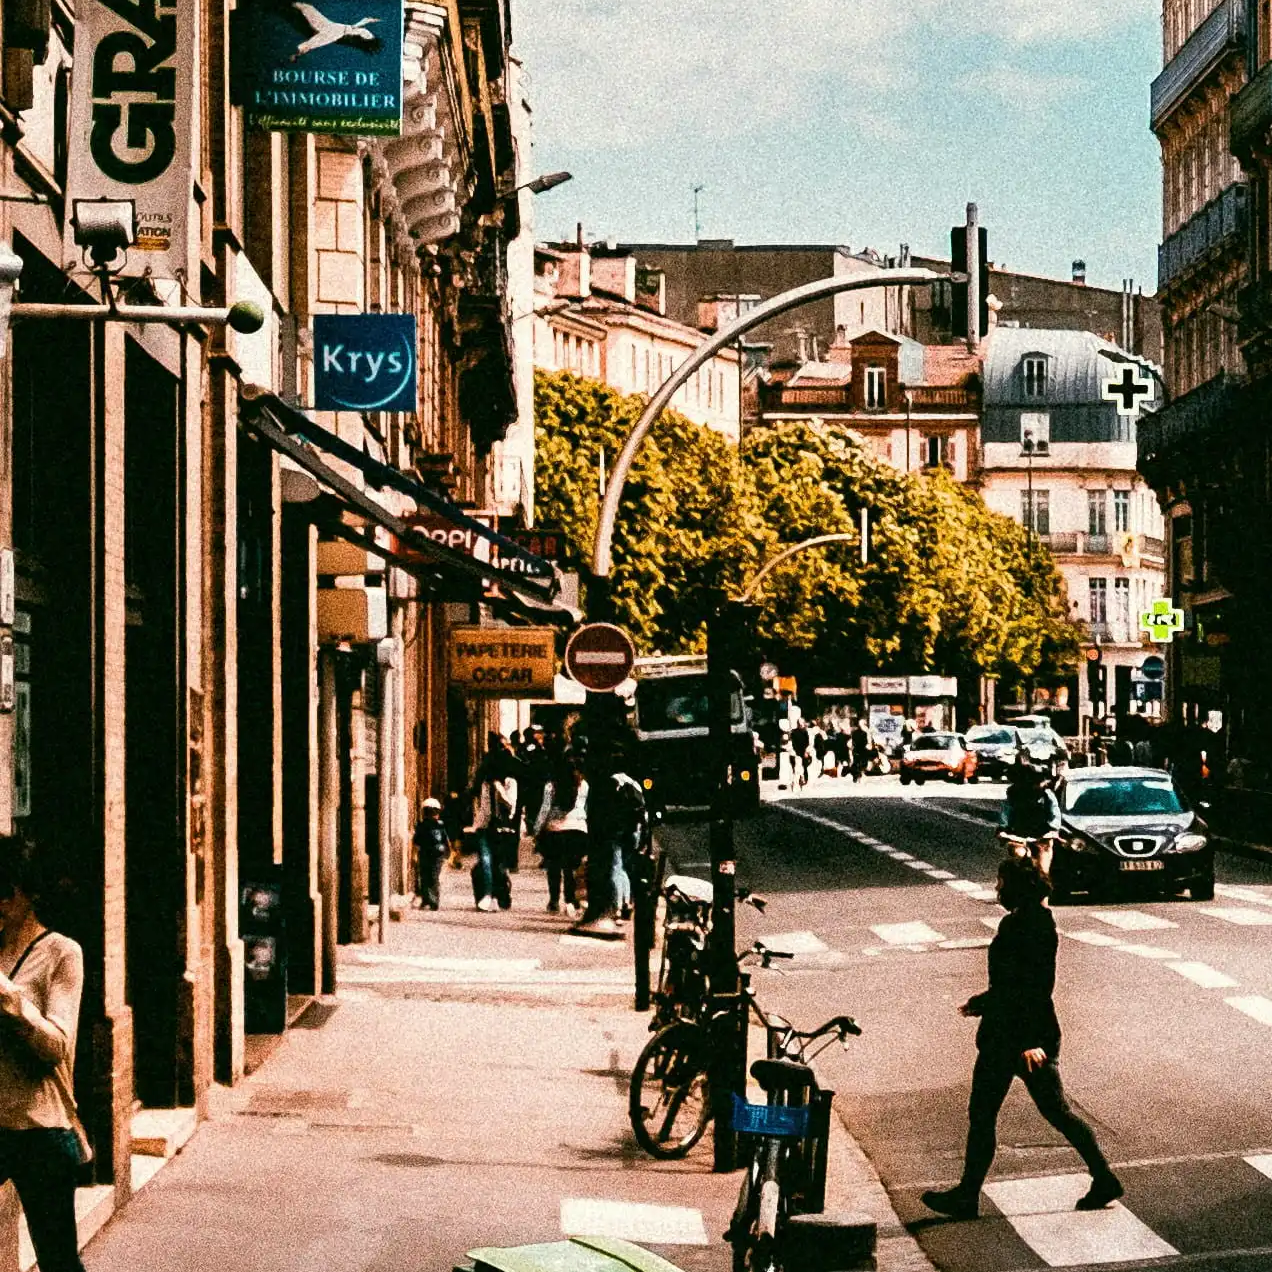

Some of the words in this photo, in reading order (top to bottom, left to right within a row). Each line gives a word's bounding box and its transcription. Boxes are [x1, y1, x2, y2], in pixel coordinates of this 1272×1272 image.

[273, 70, 349, 86] BOURSE
[355, 71, 380, 86] DE
[255, 90, 396, 108] L'IMMOBILIER
[137, 227, 171, 238] ATION
[323, 343, 402, 383] Krys
[472, 666, 533, 684] OSCAR
